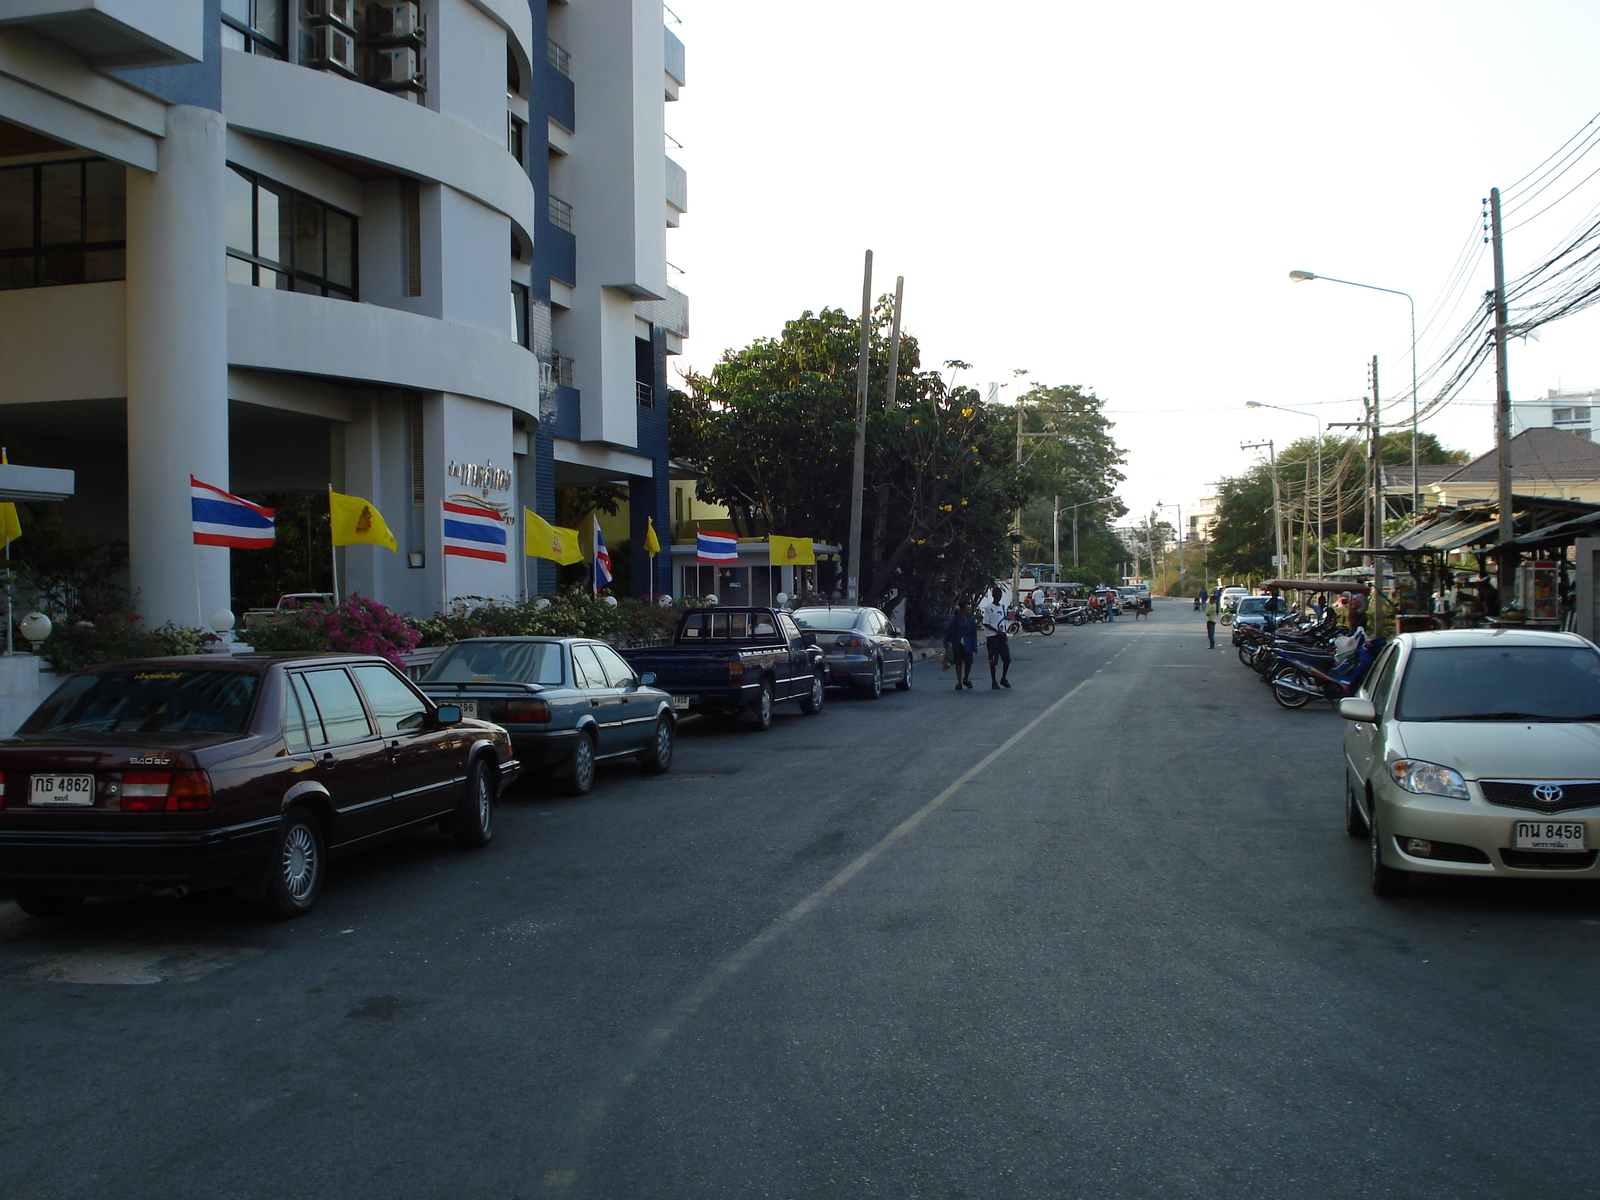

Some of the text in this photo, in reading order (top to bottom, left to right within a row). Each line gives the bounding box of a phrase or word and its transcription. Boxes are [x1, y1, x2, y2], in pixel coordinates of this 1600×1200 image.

[58, 778, 90, 792] 4862
[1518, 824, 1582, 839] กน 8458
